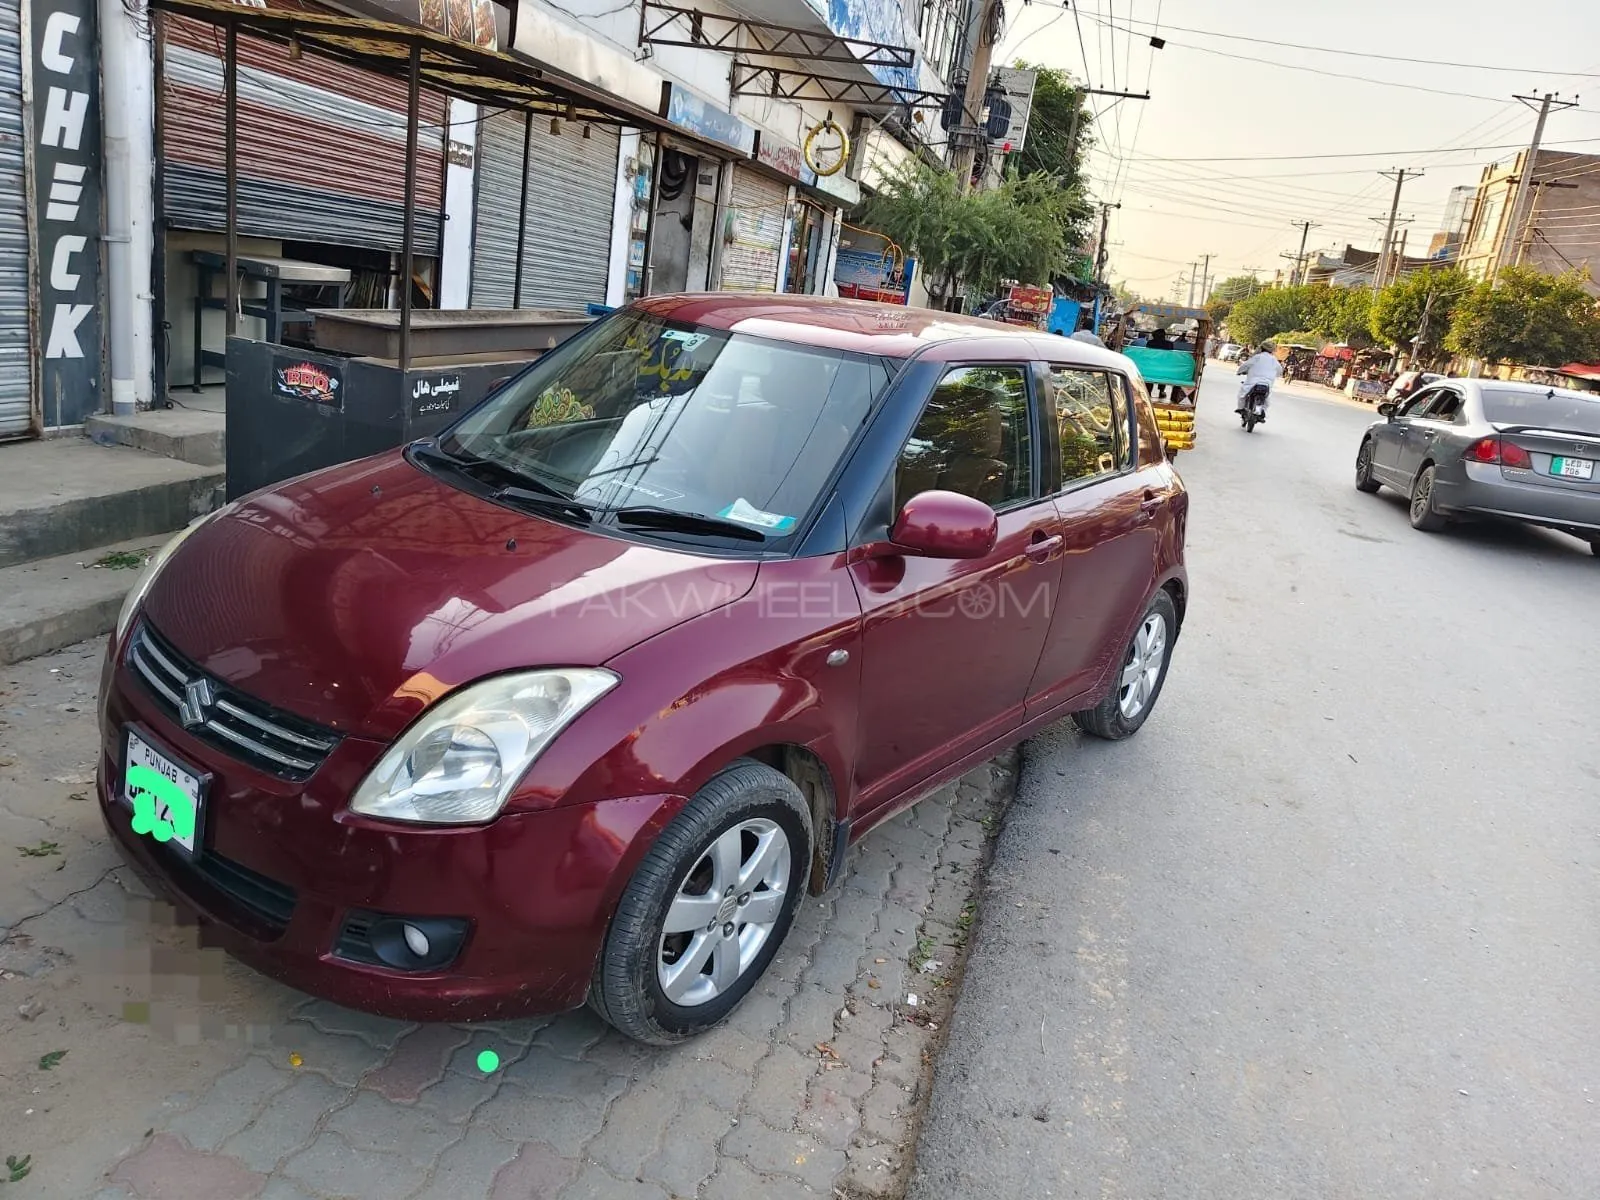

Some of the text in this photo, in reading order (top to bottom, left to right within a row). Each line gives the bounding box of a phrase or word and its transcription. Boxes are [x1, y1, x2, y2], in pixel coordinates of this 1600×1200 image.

[41, 11, 94, 359] CHECK
[286, 369, 329, 394] BBQ
[431, 376, 460, 396] فیملی
[144, 747, 178, 784] PUNJAB
